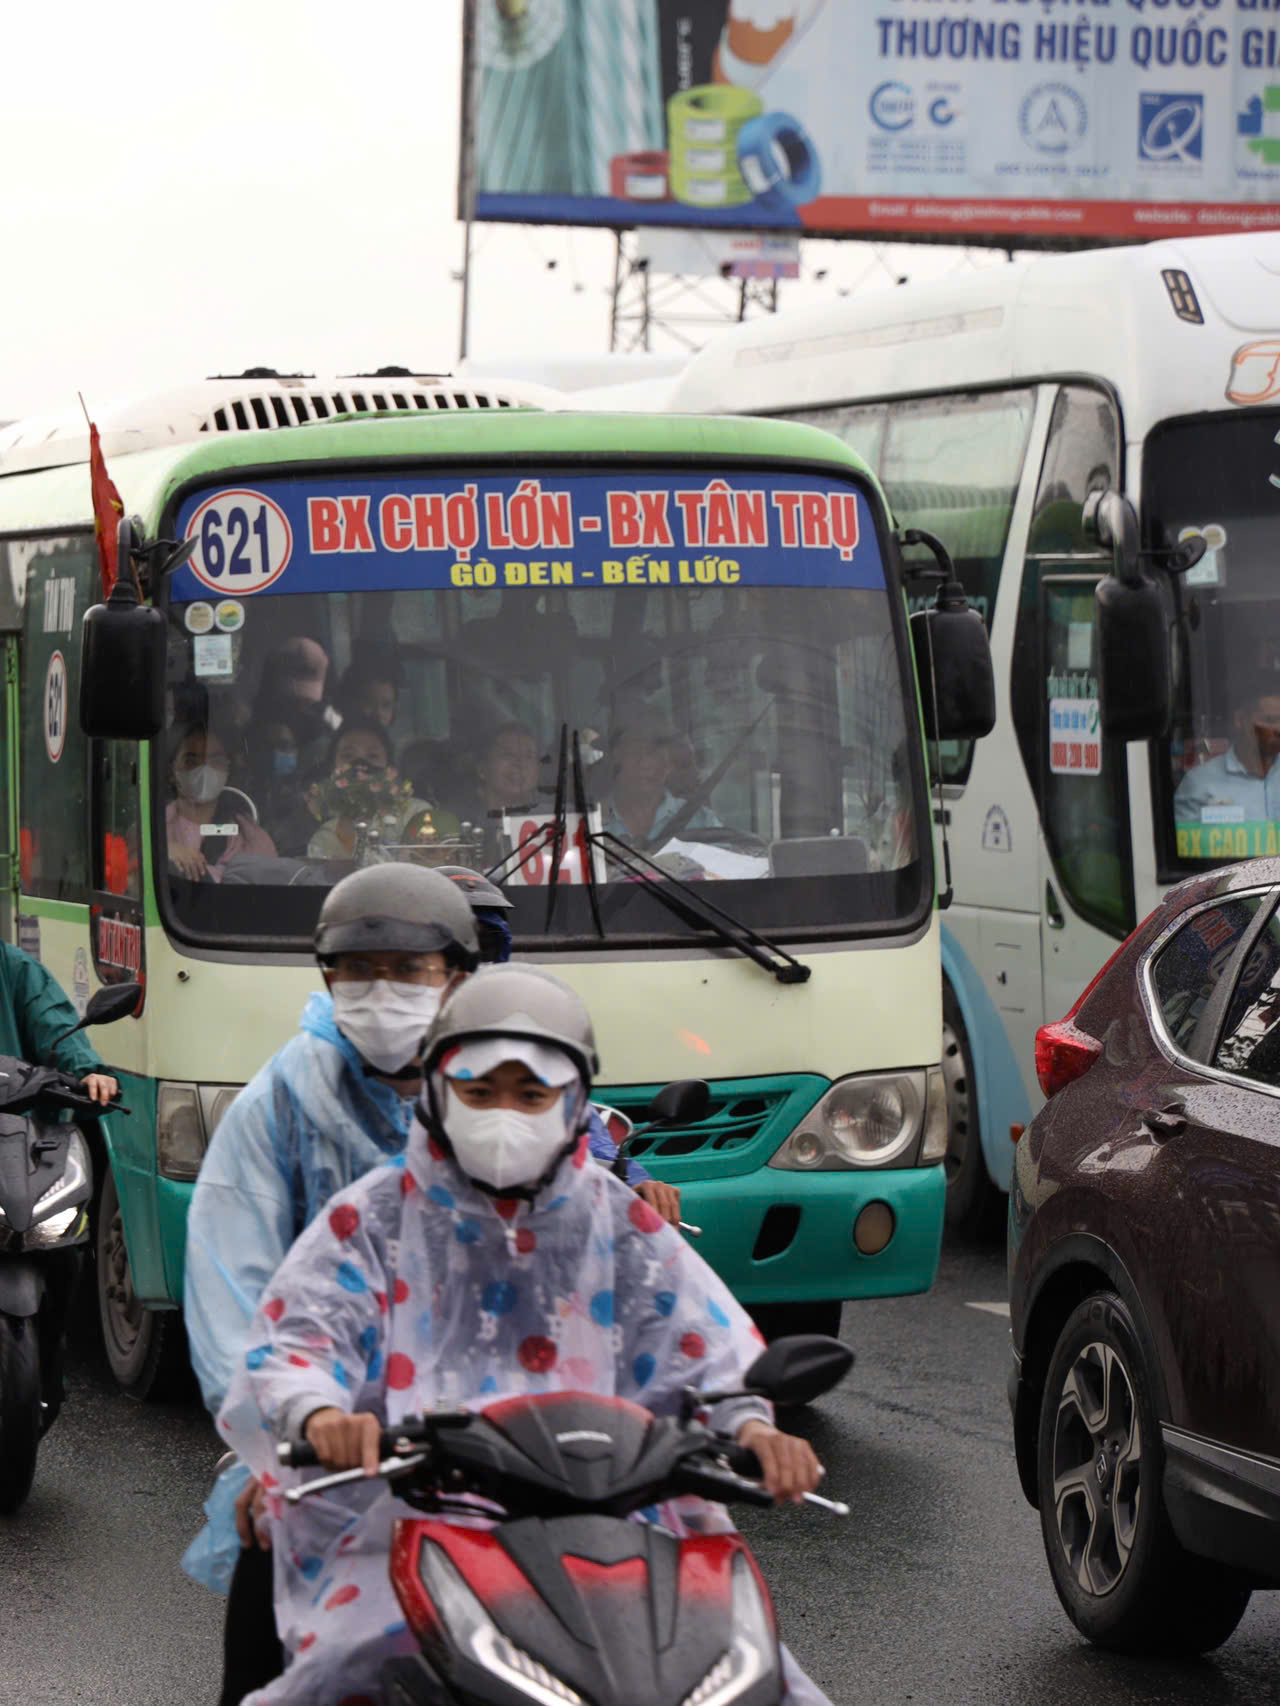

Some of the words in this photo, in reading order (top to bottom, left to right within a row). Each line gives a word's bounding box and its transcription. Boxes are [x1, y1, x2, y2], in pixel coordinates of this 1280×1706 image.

[876, 17, 1020, 60] THƯƠNG
[1033, 14, 1118, 72] HIỆU
[1130, 12, 1228, 67] QUỐC
[1241, 28, 1280, 69] GI
[202, 505, 270, 578] 621
[307, 496, 376, 554] BX
[379, 484, 479, 561] CHỢ
[485, 480, 574, 550] LỚN
[606, 491, 674, 547] BX
[674, 479, 769, 547] TÂN
[772, 491, 859, 561] TRỤ
[450, 558, 496, 586] GÒ
[504, 562, 574, 585] ĐEN
[602, 554, 670, 584] BẾN
[678, 555, 740, 584] LỨC
